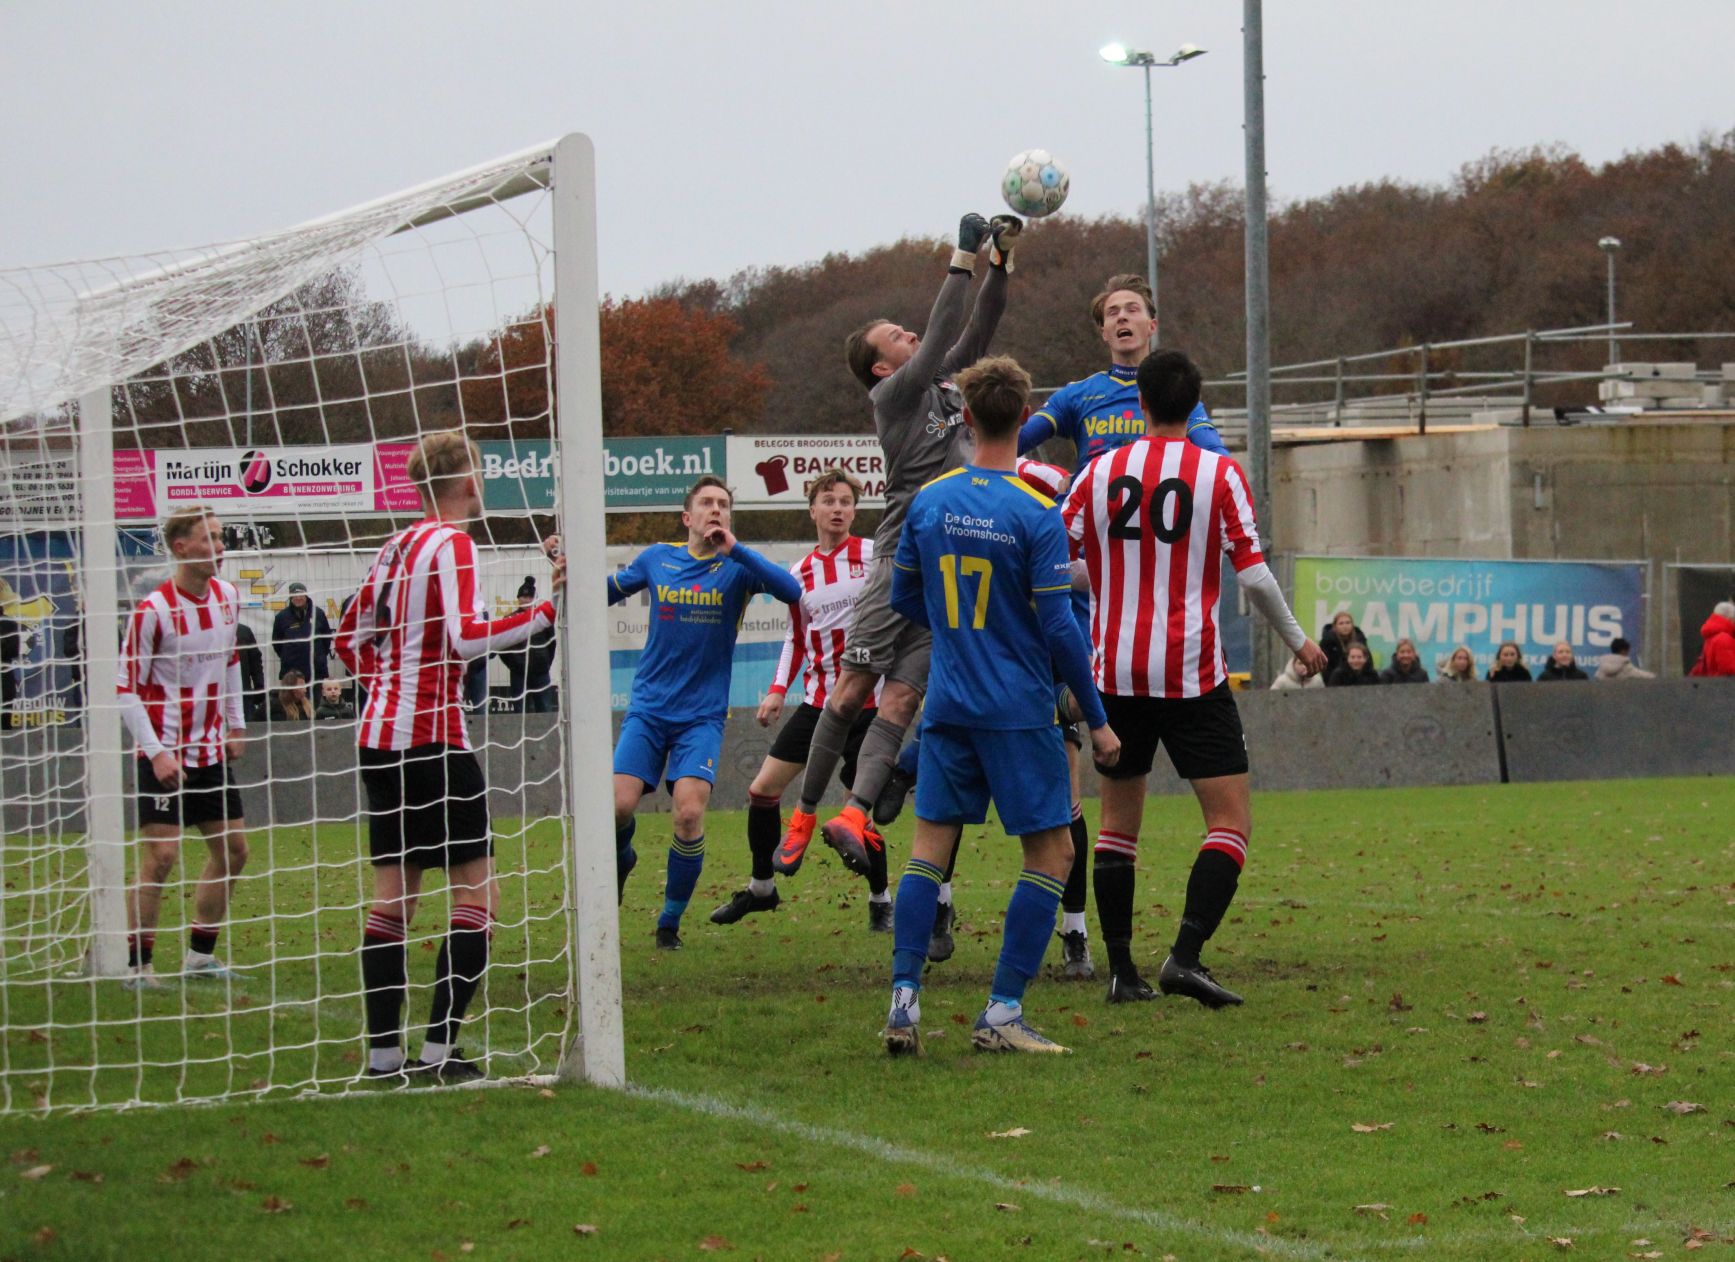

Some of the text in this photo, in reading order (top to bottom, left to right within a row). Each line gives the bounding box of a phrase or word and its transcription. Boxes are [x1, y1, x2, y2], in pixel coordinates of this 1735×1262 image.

[1084, 410, 1146, 437] Veltin
[754, 439, 795, 448] BELEGDE
[797, 439, 845, 448] BROODJES
[166, 458, 362, 482] Martijn Schokker
[655, 487, 670, 495] van
[672, 487, 684, 495] uw
[1107, 475, 1194, 544] 20
[945, 513, 994, 528] De Groot
[944, 525, 1015, 544] Vroomshoop
[657, 585, 724, 606] Veltink
[939, 554, 992, 630] 17
[1316, 571, 1493, 600] bouwbedrijf
[1314, 600, 1624, 647] KAMPHUIS
[856, 647, 871, 662] 13
[154, 797, 170, 811] 12
